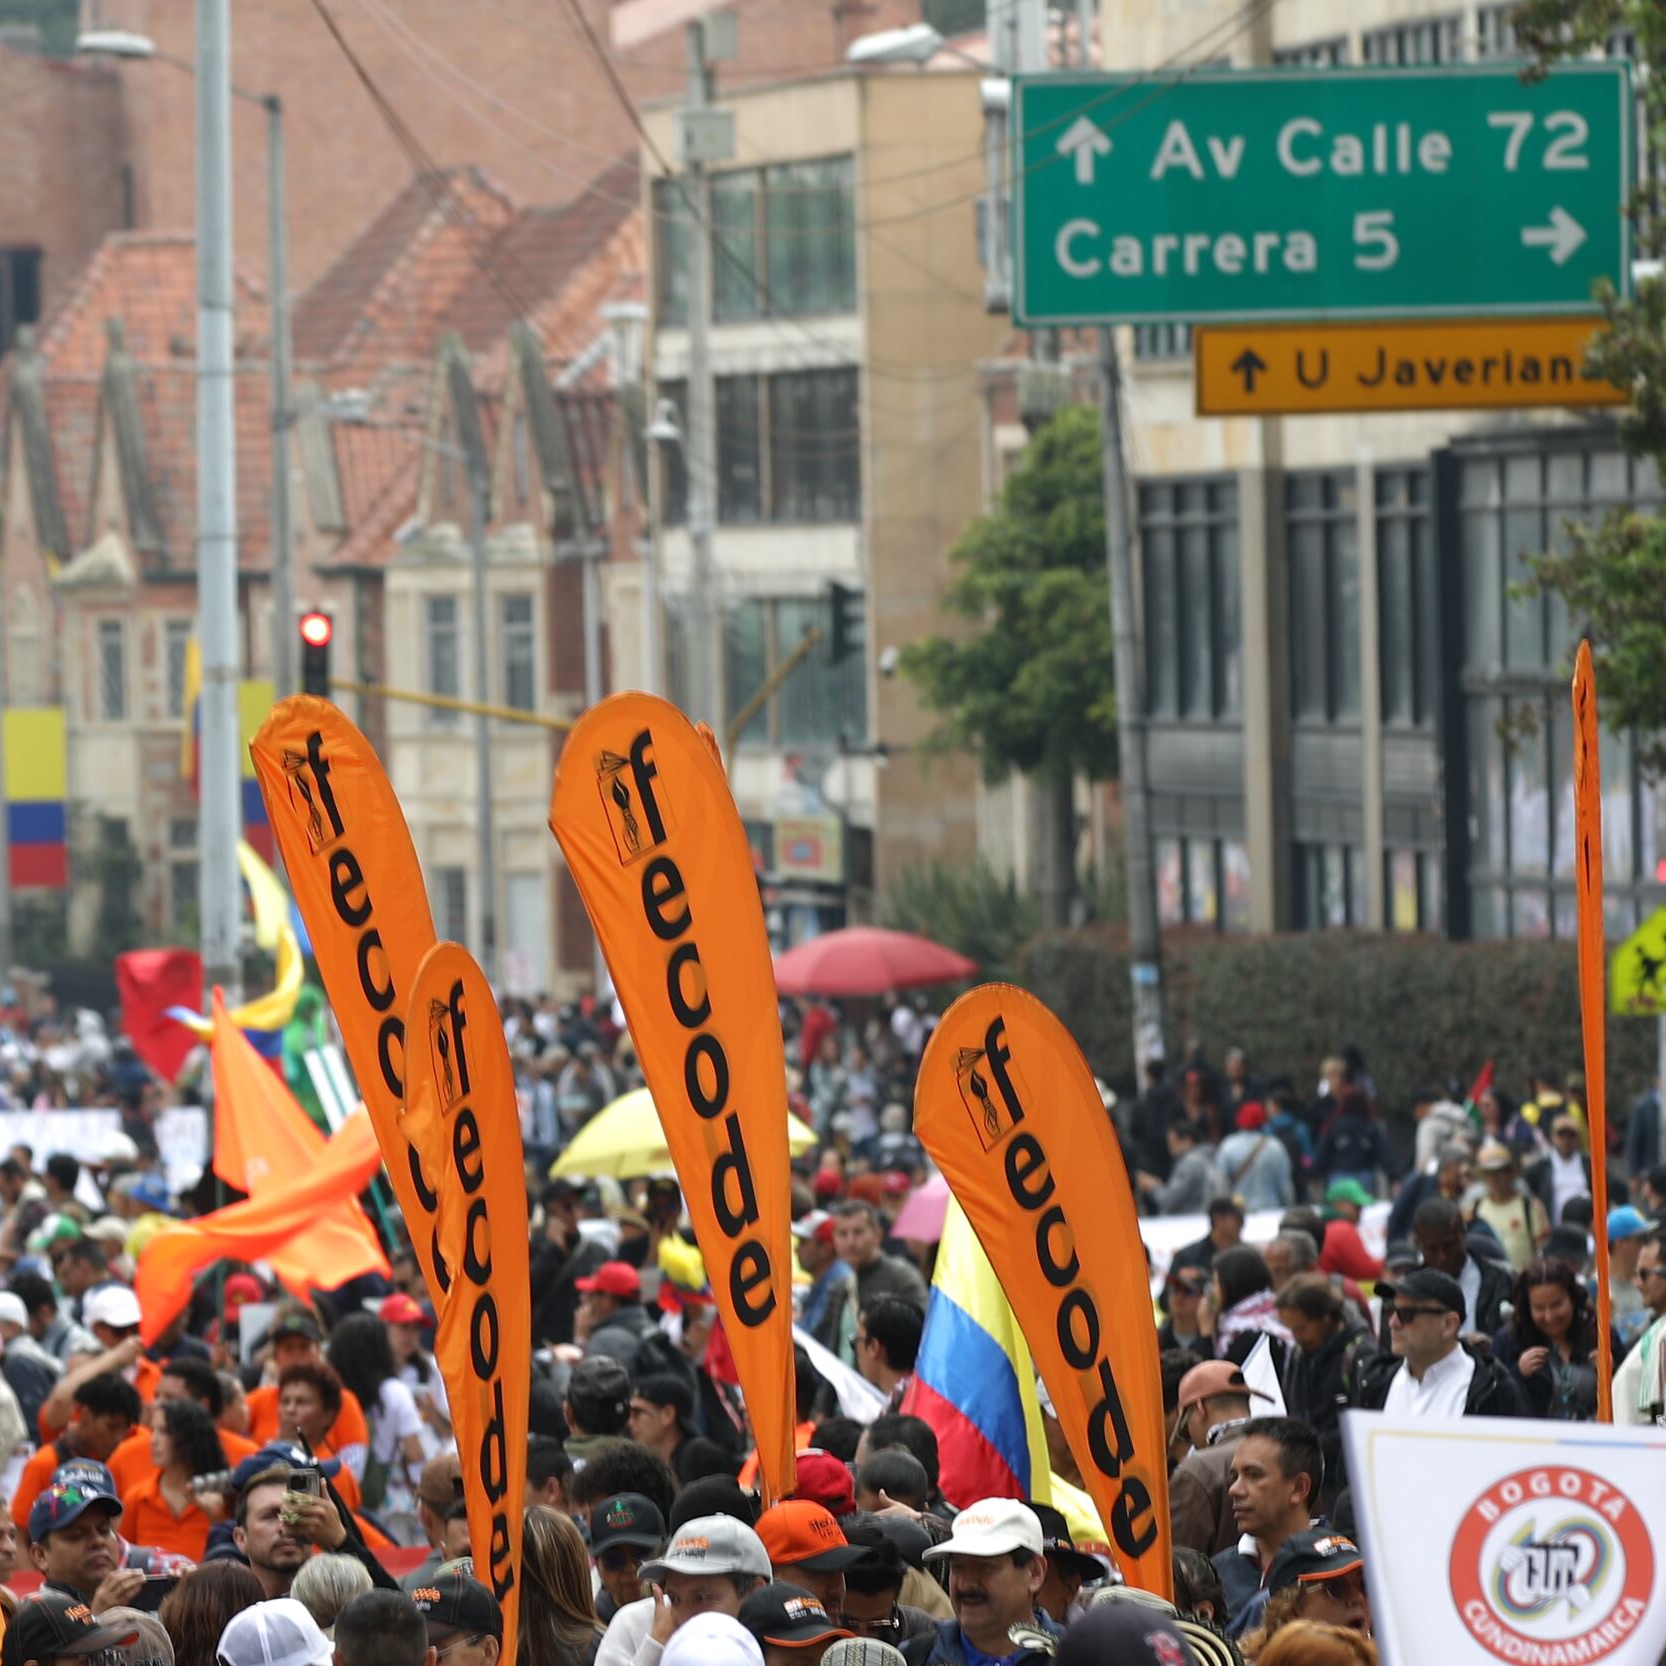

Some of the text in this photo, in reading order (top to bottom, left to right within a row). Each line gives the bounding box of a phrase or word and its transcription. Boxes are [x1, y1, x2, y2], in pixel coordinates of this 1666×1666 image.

[1149, 111, 1590, 181] Av Calle 72
[1054, 211, 1399, 279] Carrera 5
[1295, 346, 1589, 390] U Javerian
[630, 727, 777, 1329] fecode
[984, 1015, 1158, 1558] fecode
[1476, 1471, 1628, 1522] BOGOTA
